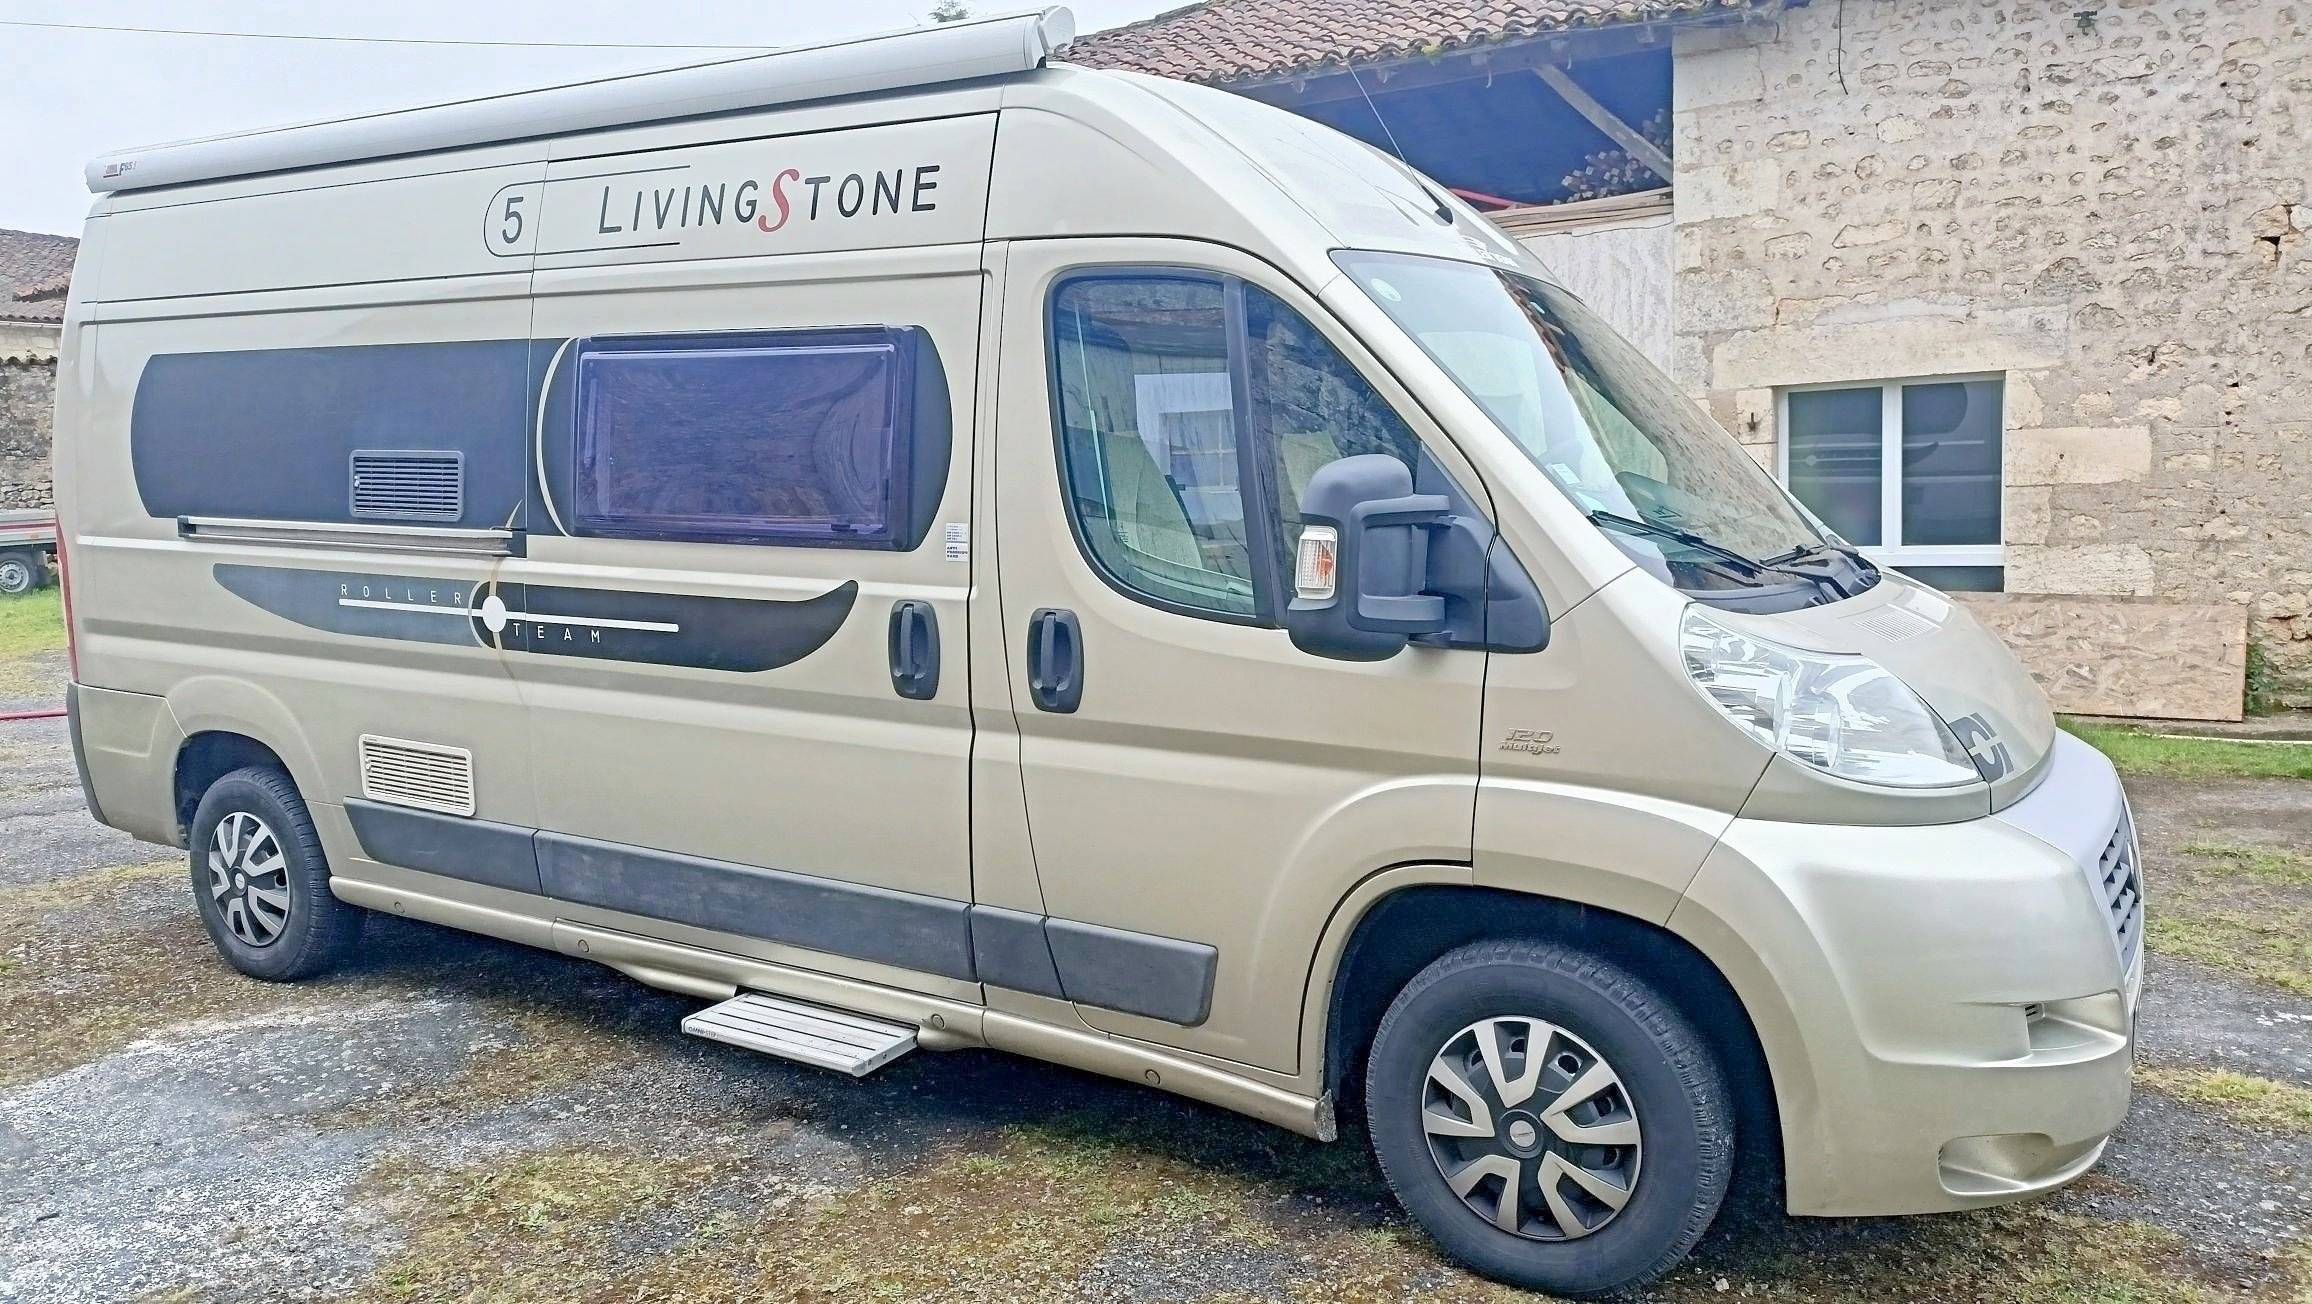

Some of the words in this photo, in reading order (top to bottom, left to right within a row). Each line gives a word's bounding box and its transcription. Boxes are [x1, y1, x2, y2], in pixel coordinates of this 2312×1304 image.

[501, 195, 525, 244] 5
[598, 164, 942, 235] LIVINGSTONE
[340, 583, 462, 605] ROLLER
[513, 622, 601, 644] TEAM
[1505, 728, 1554, 742] 120
